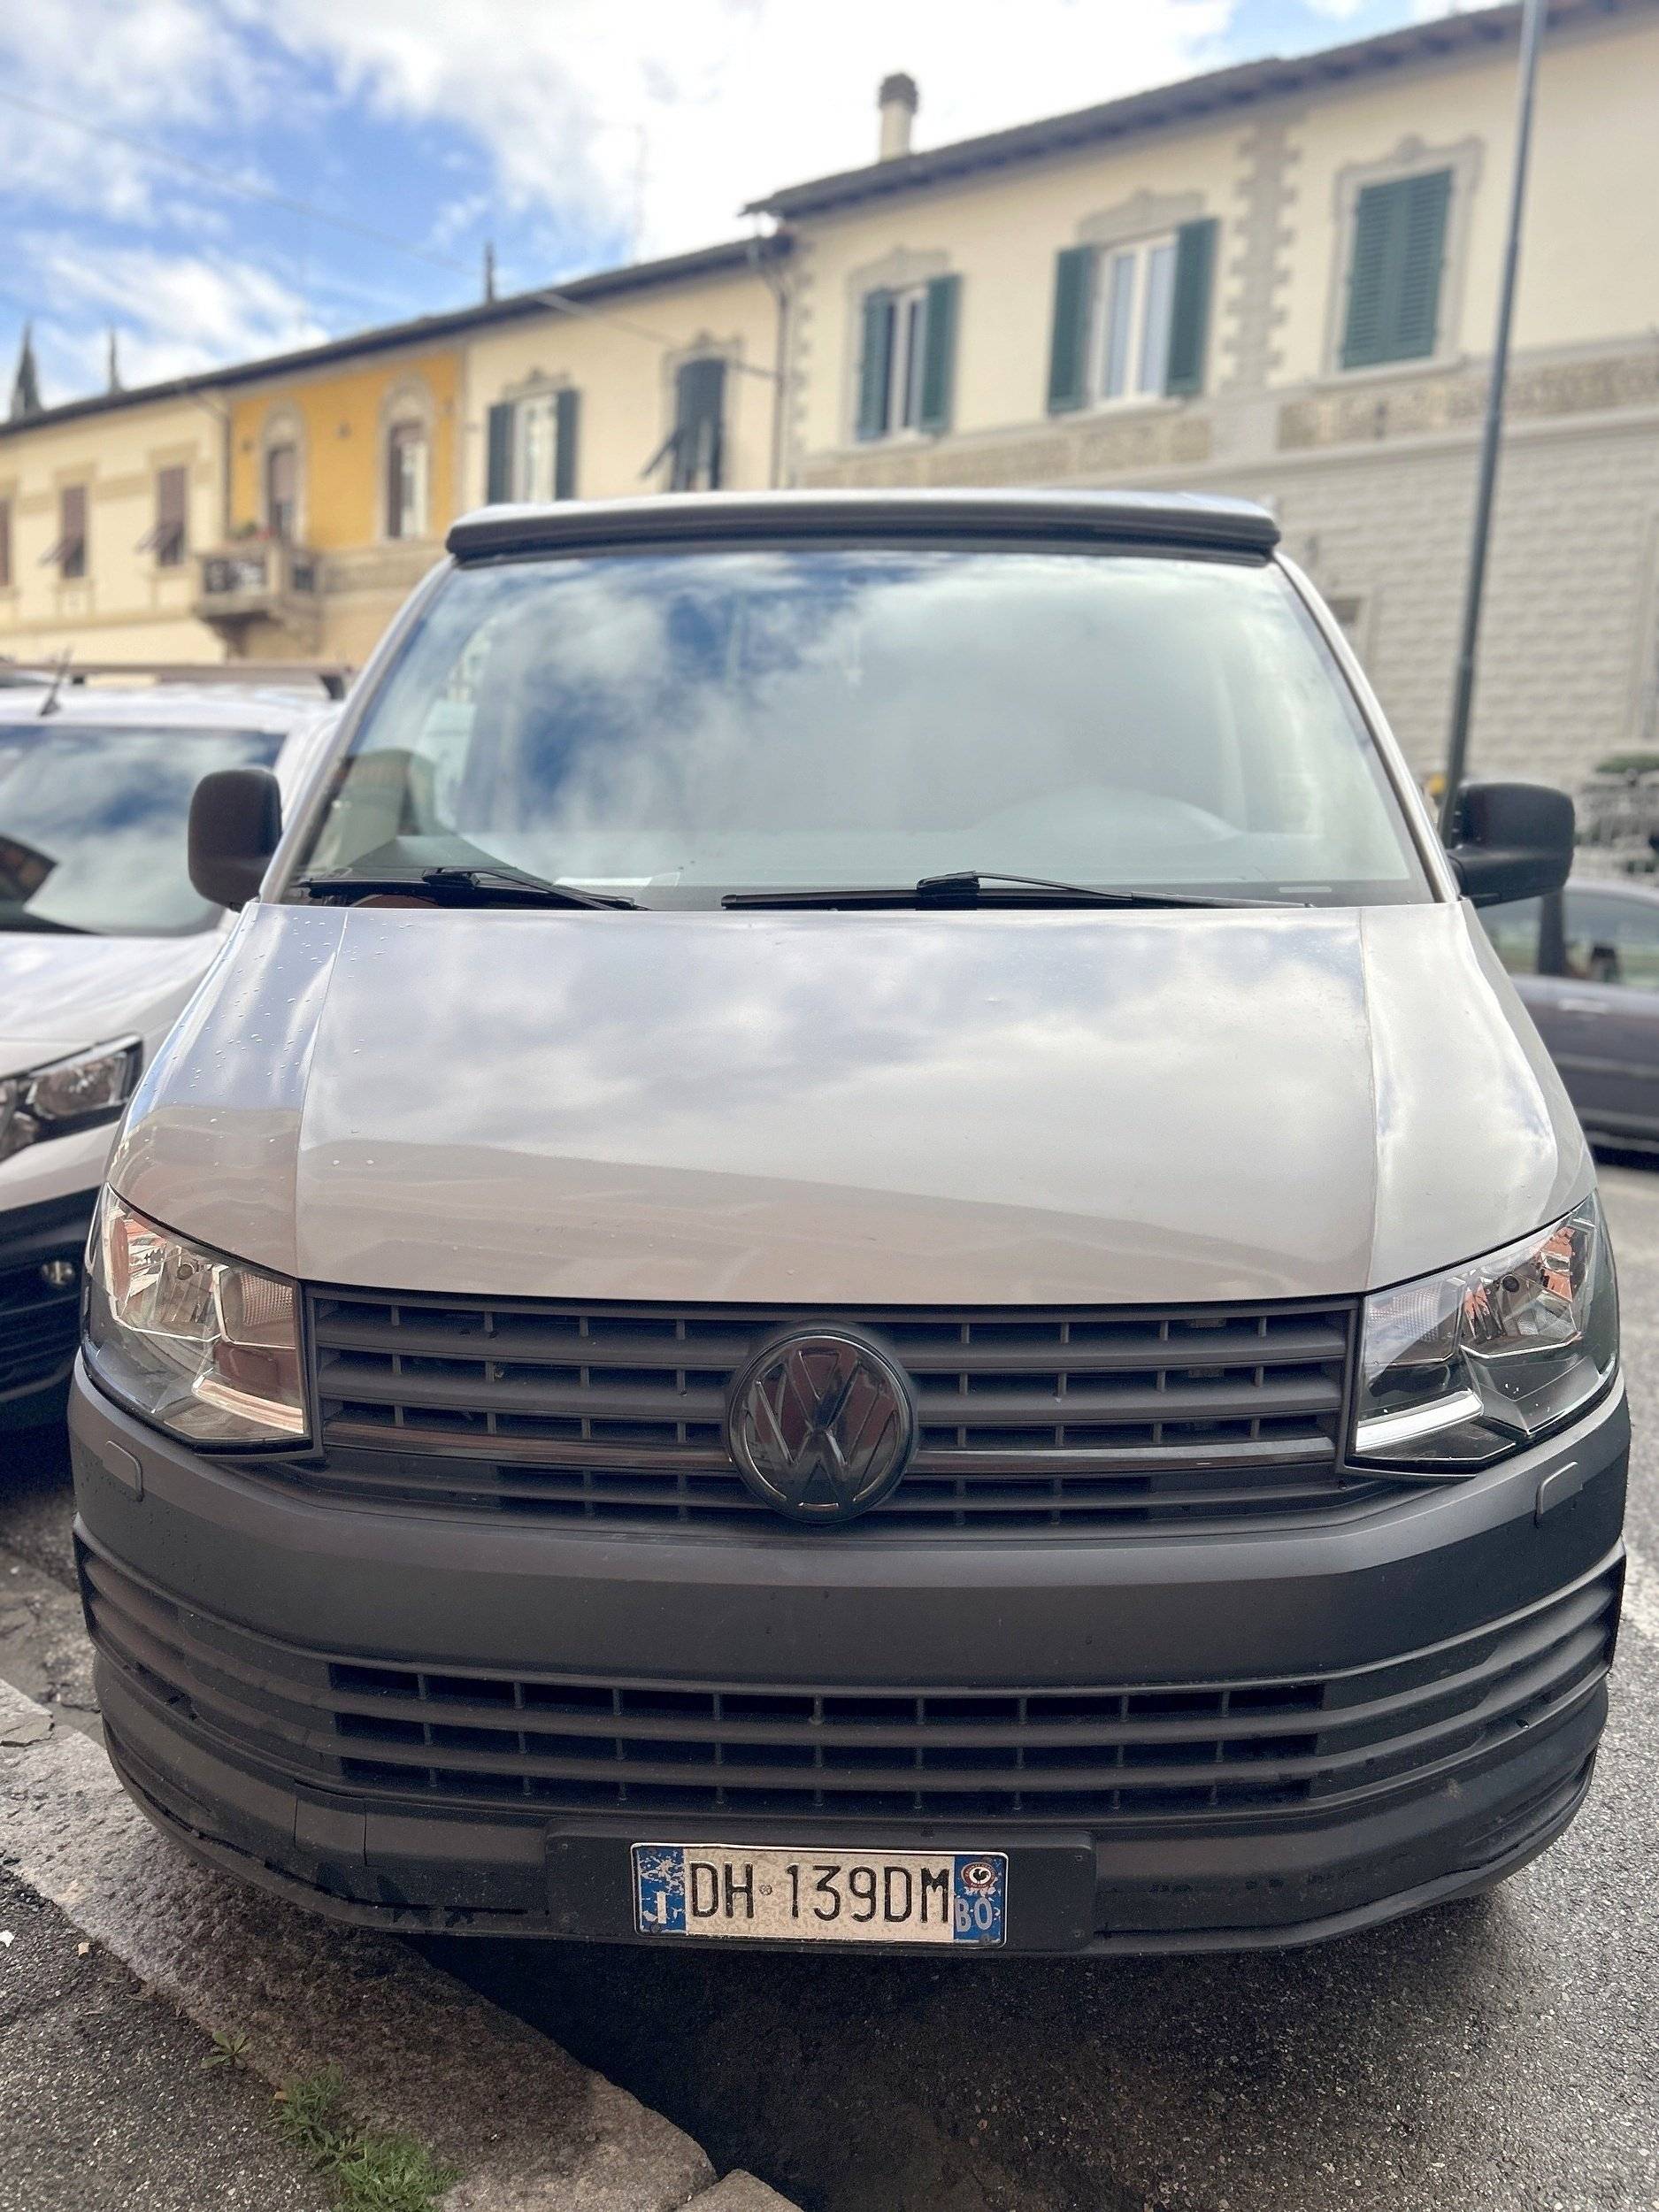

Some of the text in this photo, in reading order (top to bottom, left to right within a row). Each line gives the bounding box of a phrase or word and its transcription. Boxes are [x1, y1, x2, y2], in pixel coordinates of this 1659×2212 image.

[736, 1336, 908, 1511] VW
[657, 1891, 667, 1924] I
[691, 1862, 755, 1919] DH
[785, 1863, 950, 1924] 139DM
[955, 1897, 993, 1932] BO
